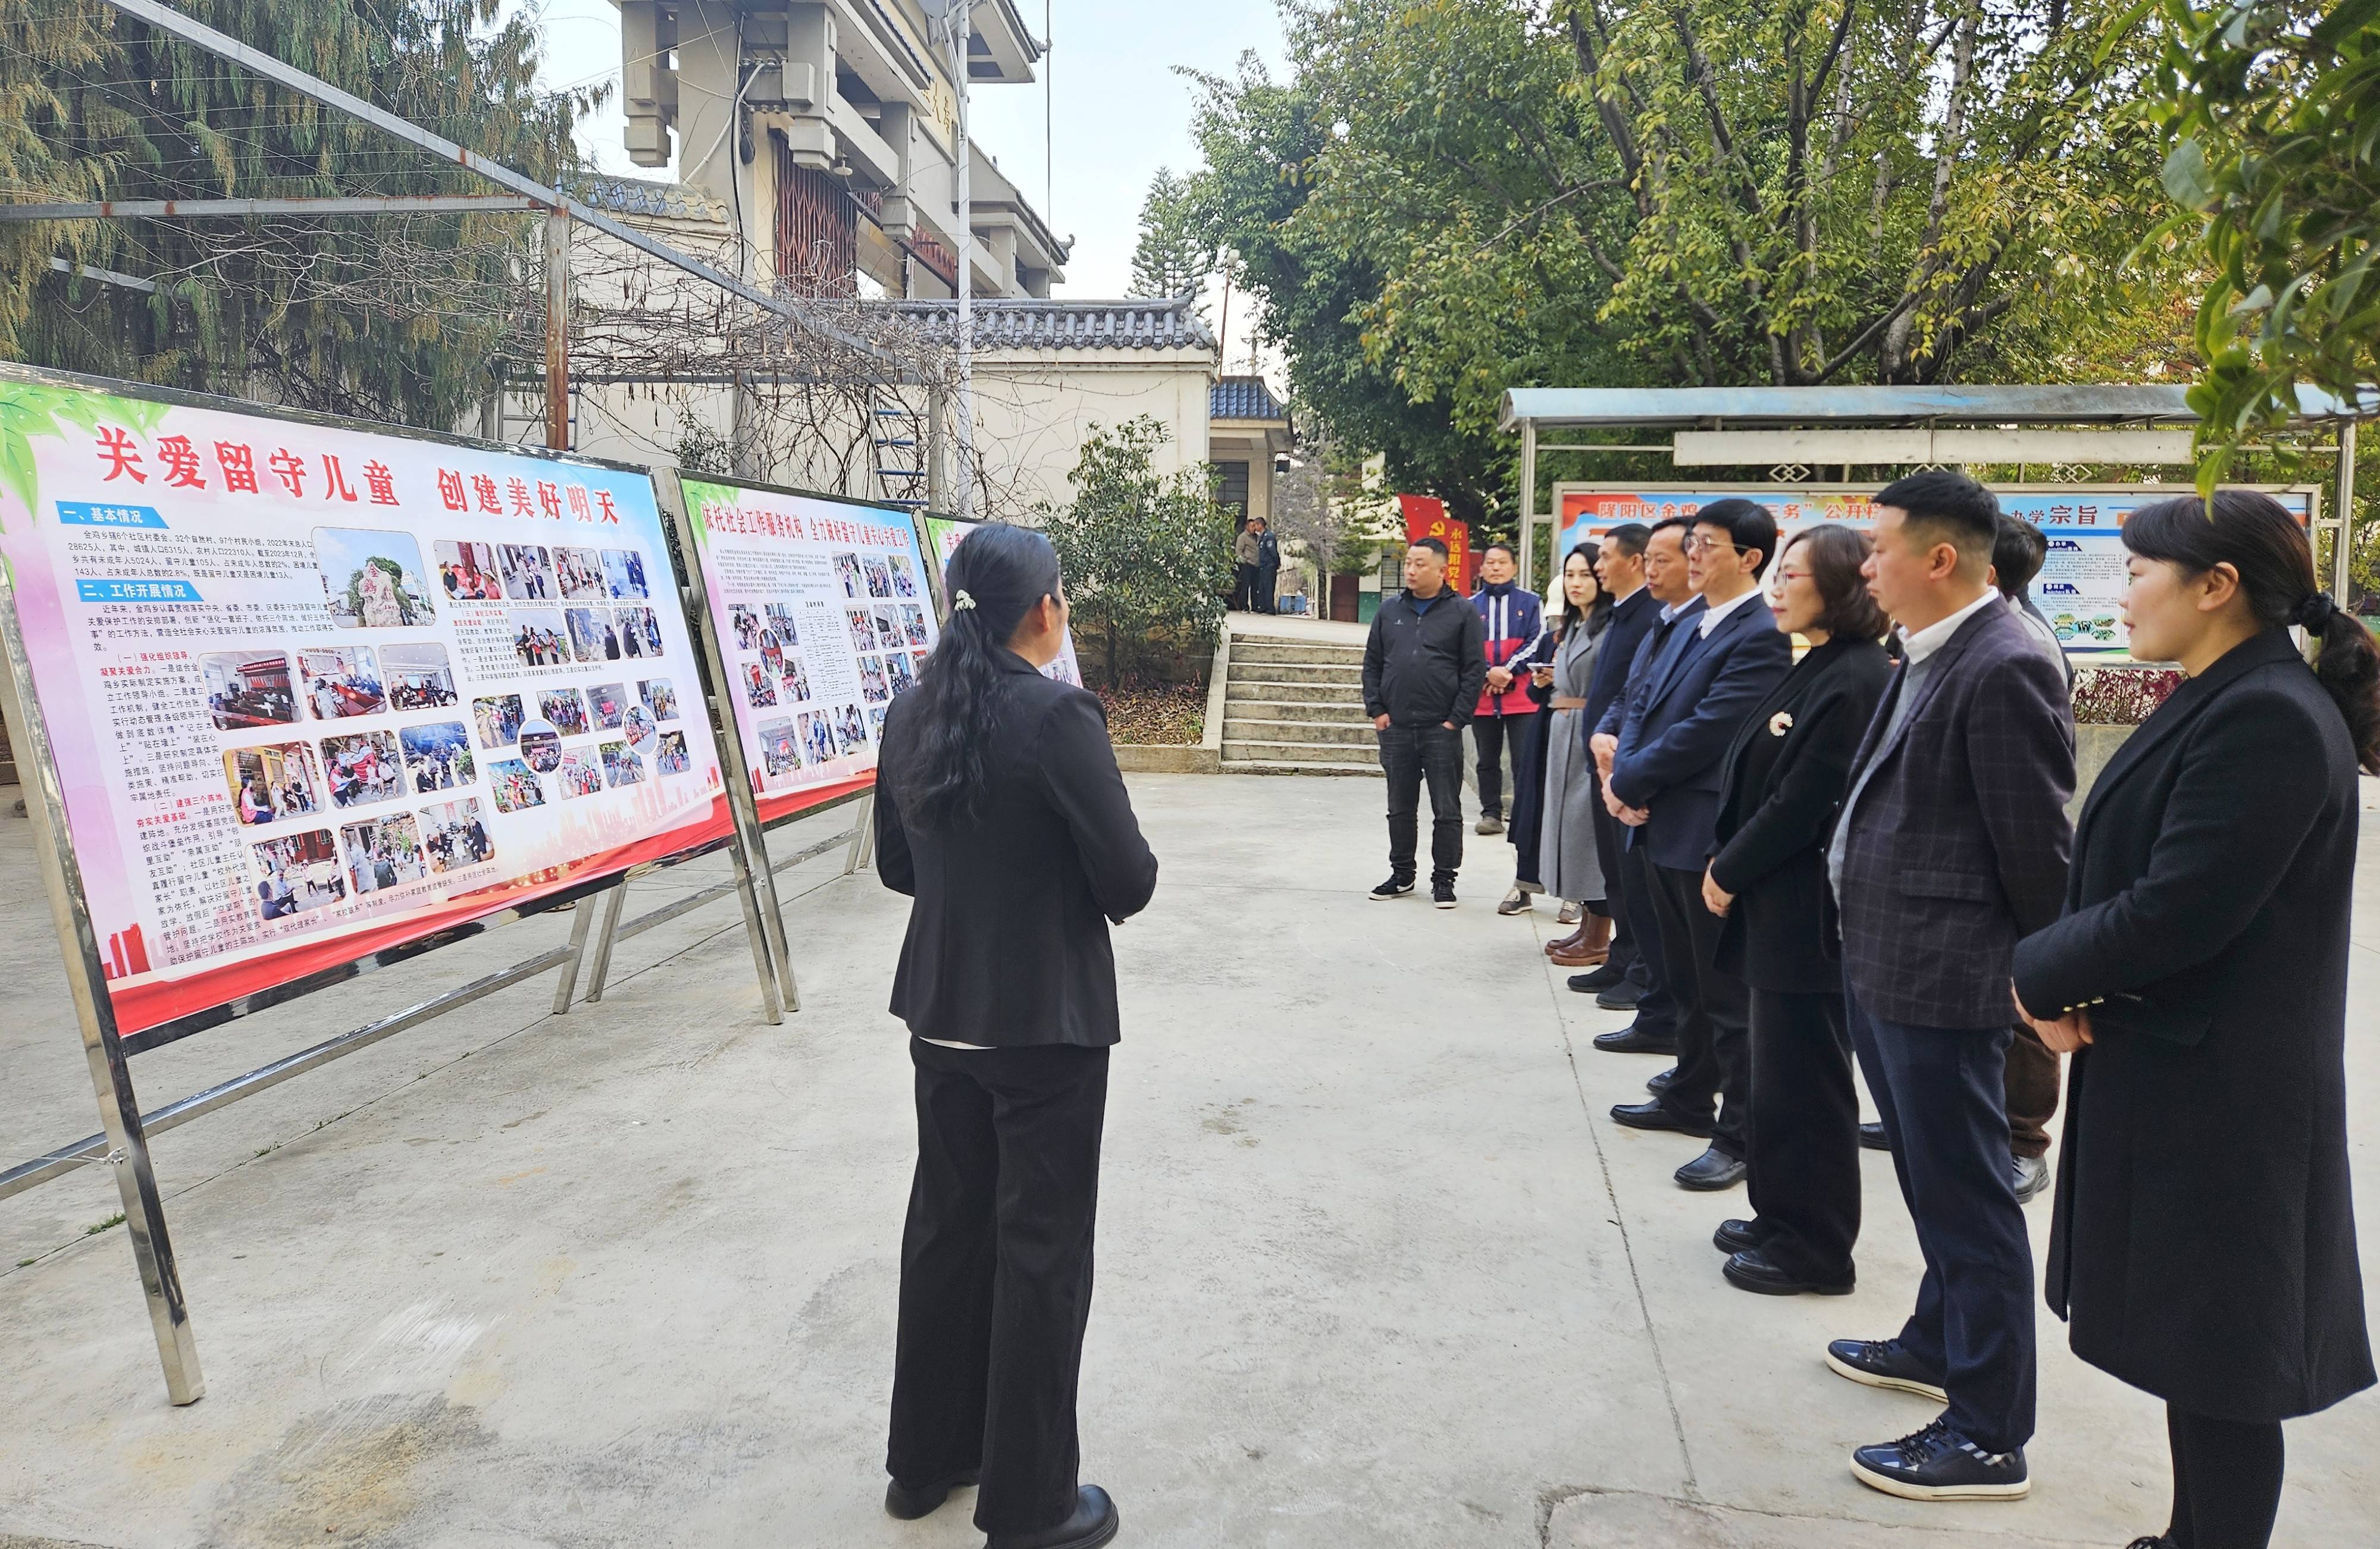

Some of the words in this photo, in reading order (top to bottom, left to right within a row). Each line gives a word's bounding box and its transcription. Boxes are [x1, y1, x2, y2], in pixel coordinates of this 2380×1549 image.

[96, 426, 400, 506] 关爱留守儿童
[438, 468, 618, 524] 创建美好明天
[63, 507, 143, 523] 一、基本情况
[701, 502, 803, 540] 依托社会工作服务机构
[810, 517, 909, 548] 全力做好留守儿童关心关爱工作
[83, 584, 186, 598] 二、工作开展情况
